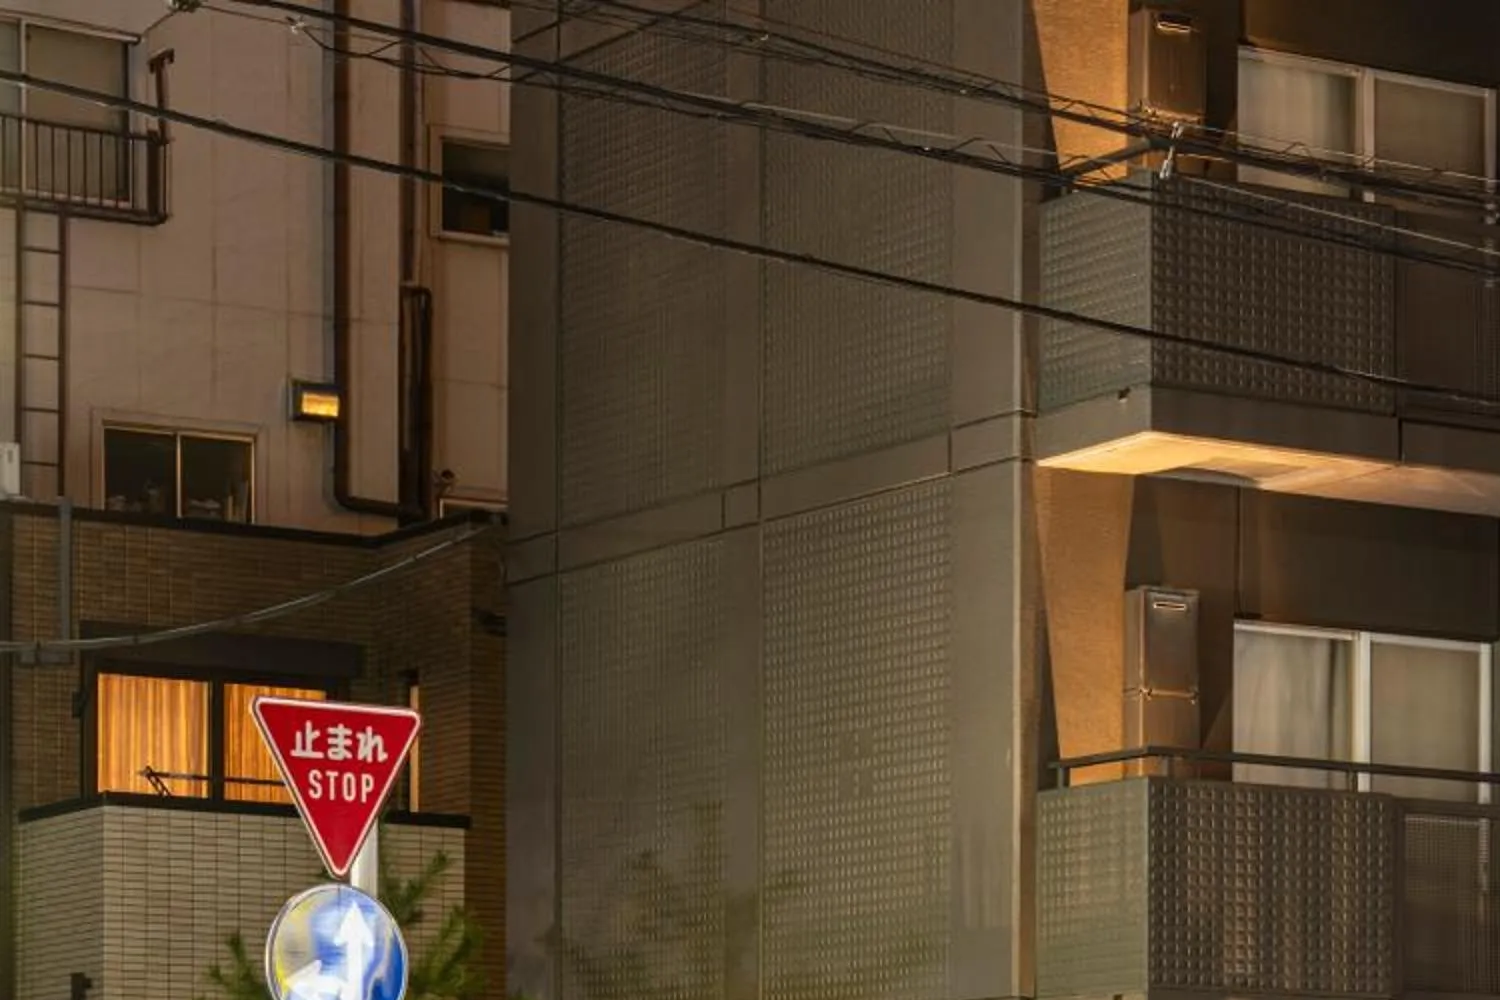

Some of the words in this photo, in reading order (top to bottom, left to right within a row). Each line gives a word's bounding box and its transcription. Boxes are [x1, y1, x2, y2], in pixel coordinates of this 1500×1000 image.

[290, 720, 389, 764] 止まれ
[308, 769, 375, 804] STOP
